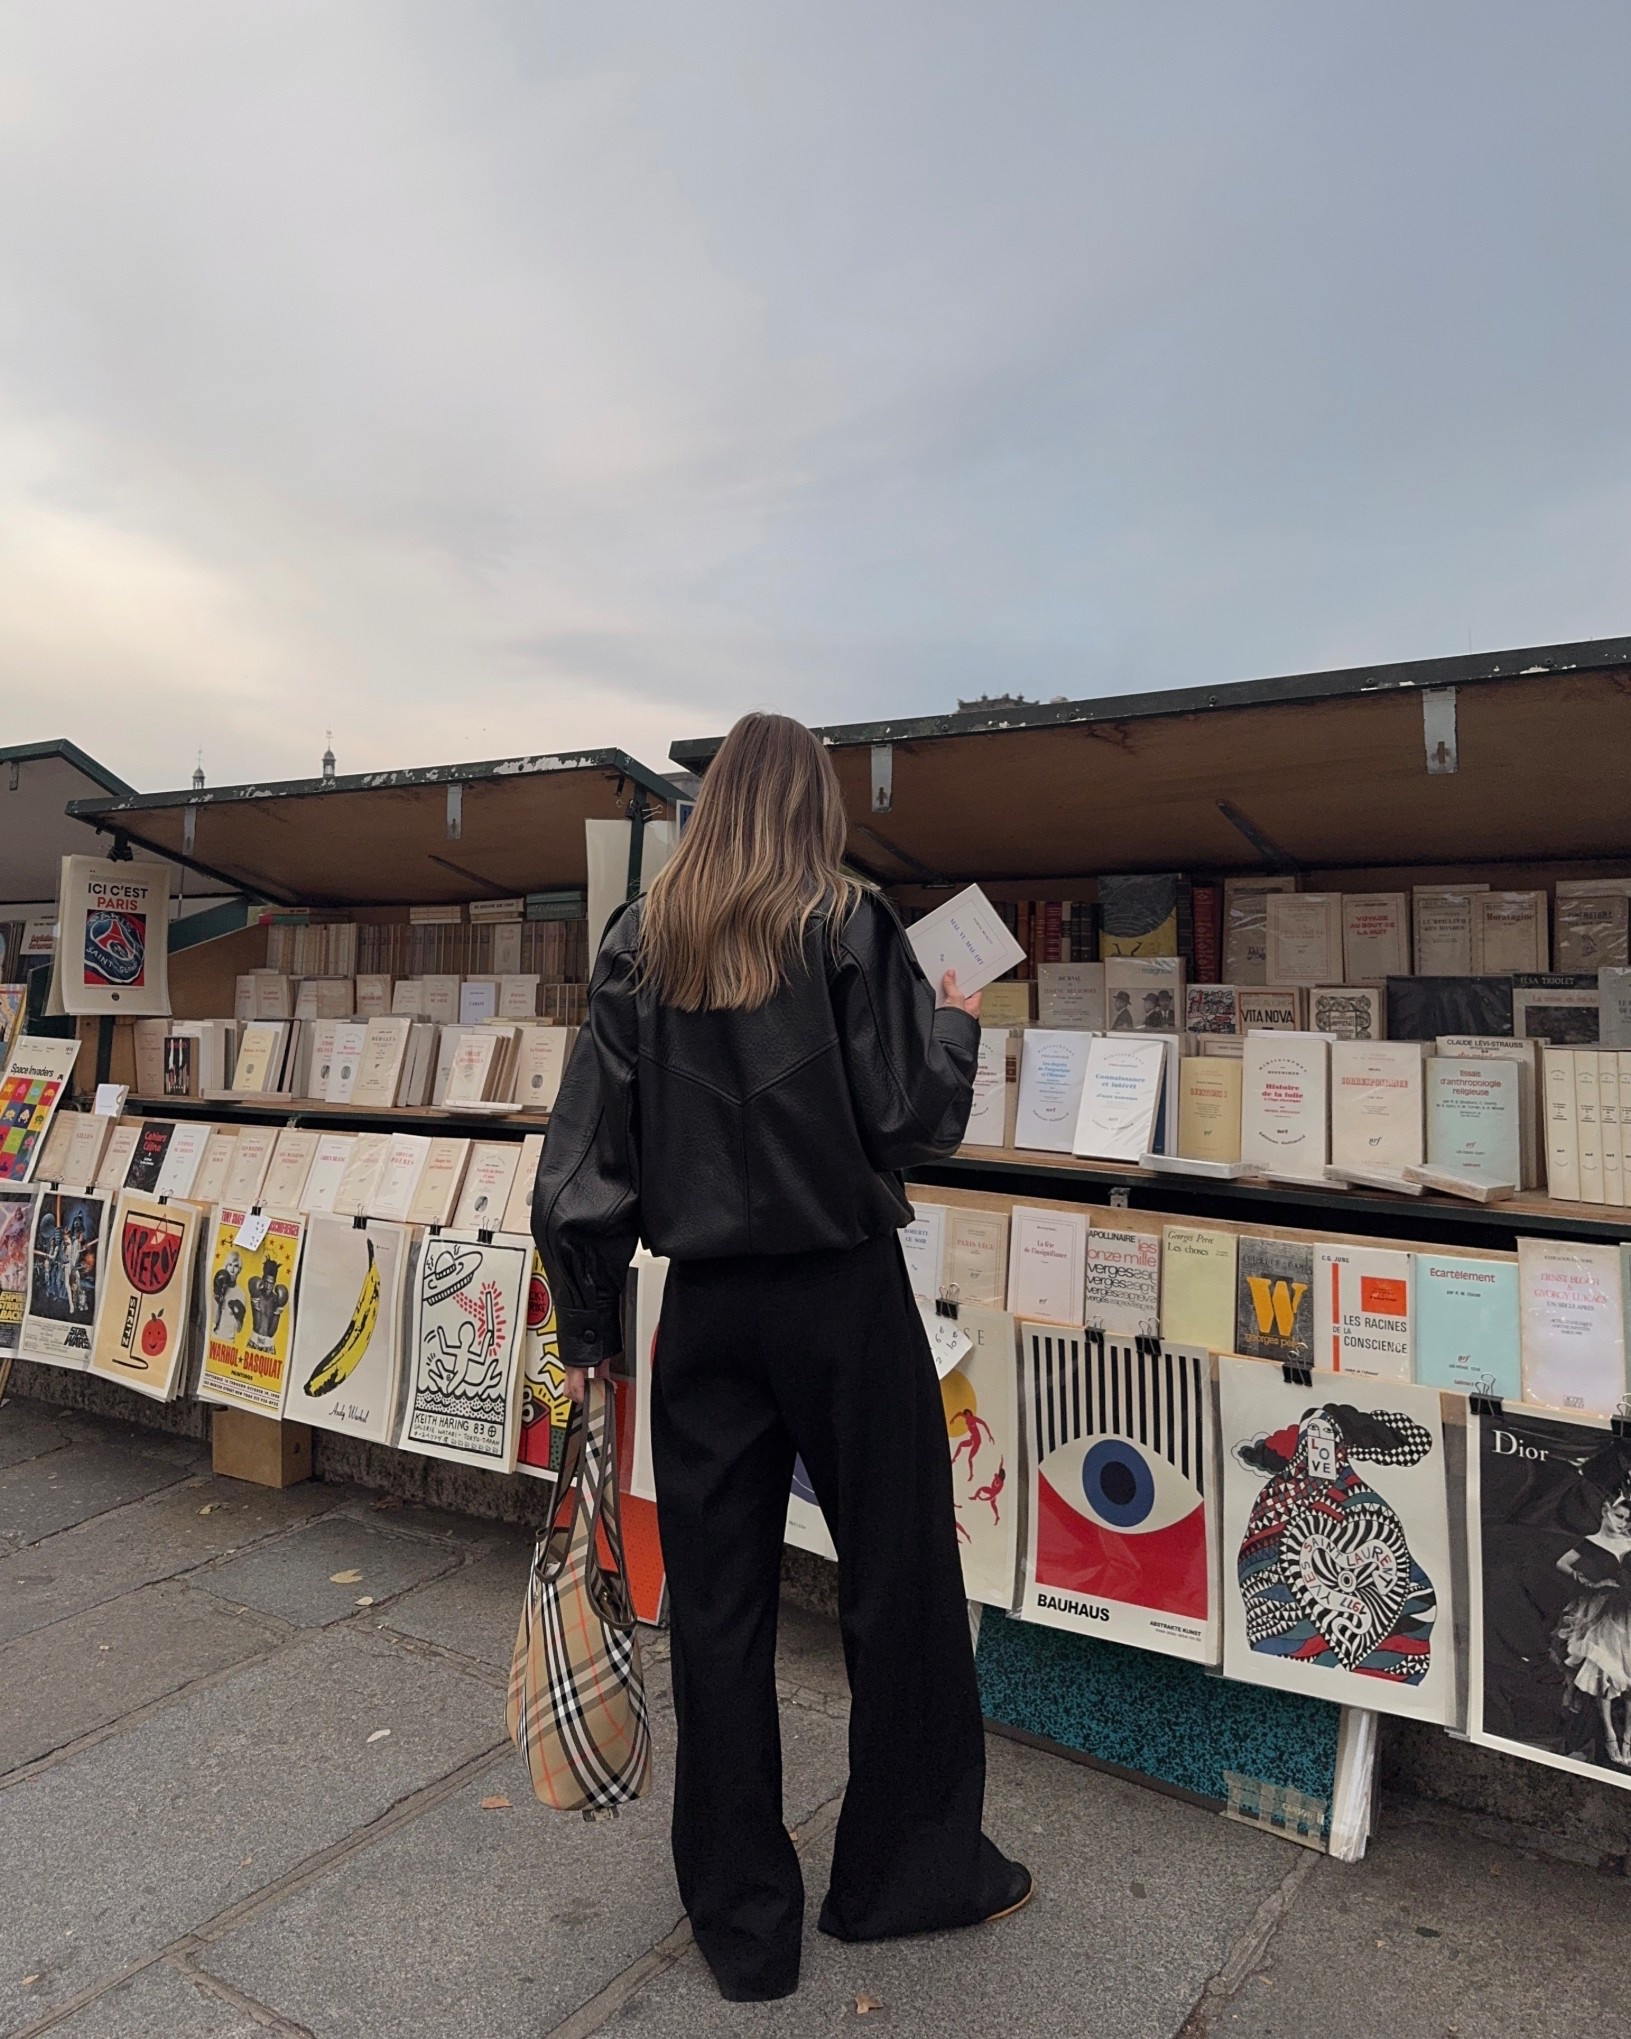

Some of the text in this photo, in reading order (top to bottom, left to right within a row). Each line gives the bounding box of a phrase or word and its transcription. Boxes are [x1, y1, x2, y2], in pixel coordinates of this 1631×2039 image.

[88, 883, 148, 899] ICI C'EST
[97, 897, 138, 911] PARIS
[1542, 977, 1574, 985] TRIOLET
[1241, 1009, 1294, 1023] VITA NOVA
[1475, 1039, 1523, 1048] LÉVI-STRAUSS
[11, 1063, 54, 1077] Space Invaders
[1265, 1083, 1300, 1091] Histoire
[1440, 1079, 1502, 1088] d'anthropologie
[1284, 1091, 1303, 1099] folie
[1452, 1088, 1489, 1096] religieuse
[144, 1131, 168, 1142] Cahiers
[1088, 1230, 1157, 1254] APOLLINAIRE les
[1168, 1231, 1214, 1244] Georges Perec
[1032, 1247, 1068, 1259] l'insignifiance
[1167, 1242, 1209, 1256] Les choses
[1087, 1249, 1157, 1267] onze mille
[1087, 1263, 1134, 1278] verges
[1086, 1275, 1126, 1289] verges
[1540, 1273, 1568, 1283] ERNST
[1086, 1286, 1118, 1298] verges
[1246, 1276, 1308, 1336] W
[1343, 1315, 1407, 1333] LES RACINES
[1343, 1327, 1352, 1335] LA
[69, 1327, 88, 1337] STAR
[64, 1334, 92, 1350] WARS
[1245, 1333, 1279, 1346] georges
[1343, 1335, 1408, 1354] CONSCIENCE
[209, 1340, 283, 1379] WARHOL BASQUIAT
[231, 1370, 253, 1381] PAINTINGS
[329, 1402, 370, 1424] Andy Warhol
[413, 1423, 435, 1433] GALERIE
[414, 1412, 485, 1435] KEITH HARING 83
[1491, 1429, 1549, 1462] Dior
[1303, 1537, 1343, 1560] SAINT
[1346, 1545, 1394, 1589] LAURENT
[1037, 1593, 1110, 1622] BAUHAUS
[1149, 1620, 1182, 1633] ABSTRAKTE
[1182, 1628, 1202, 1637] KUNST
